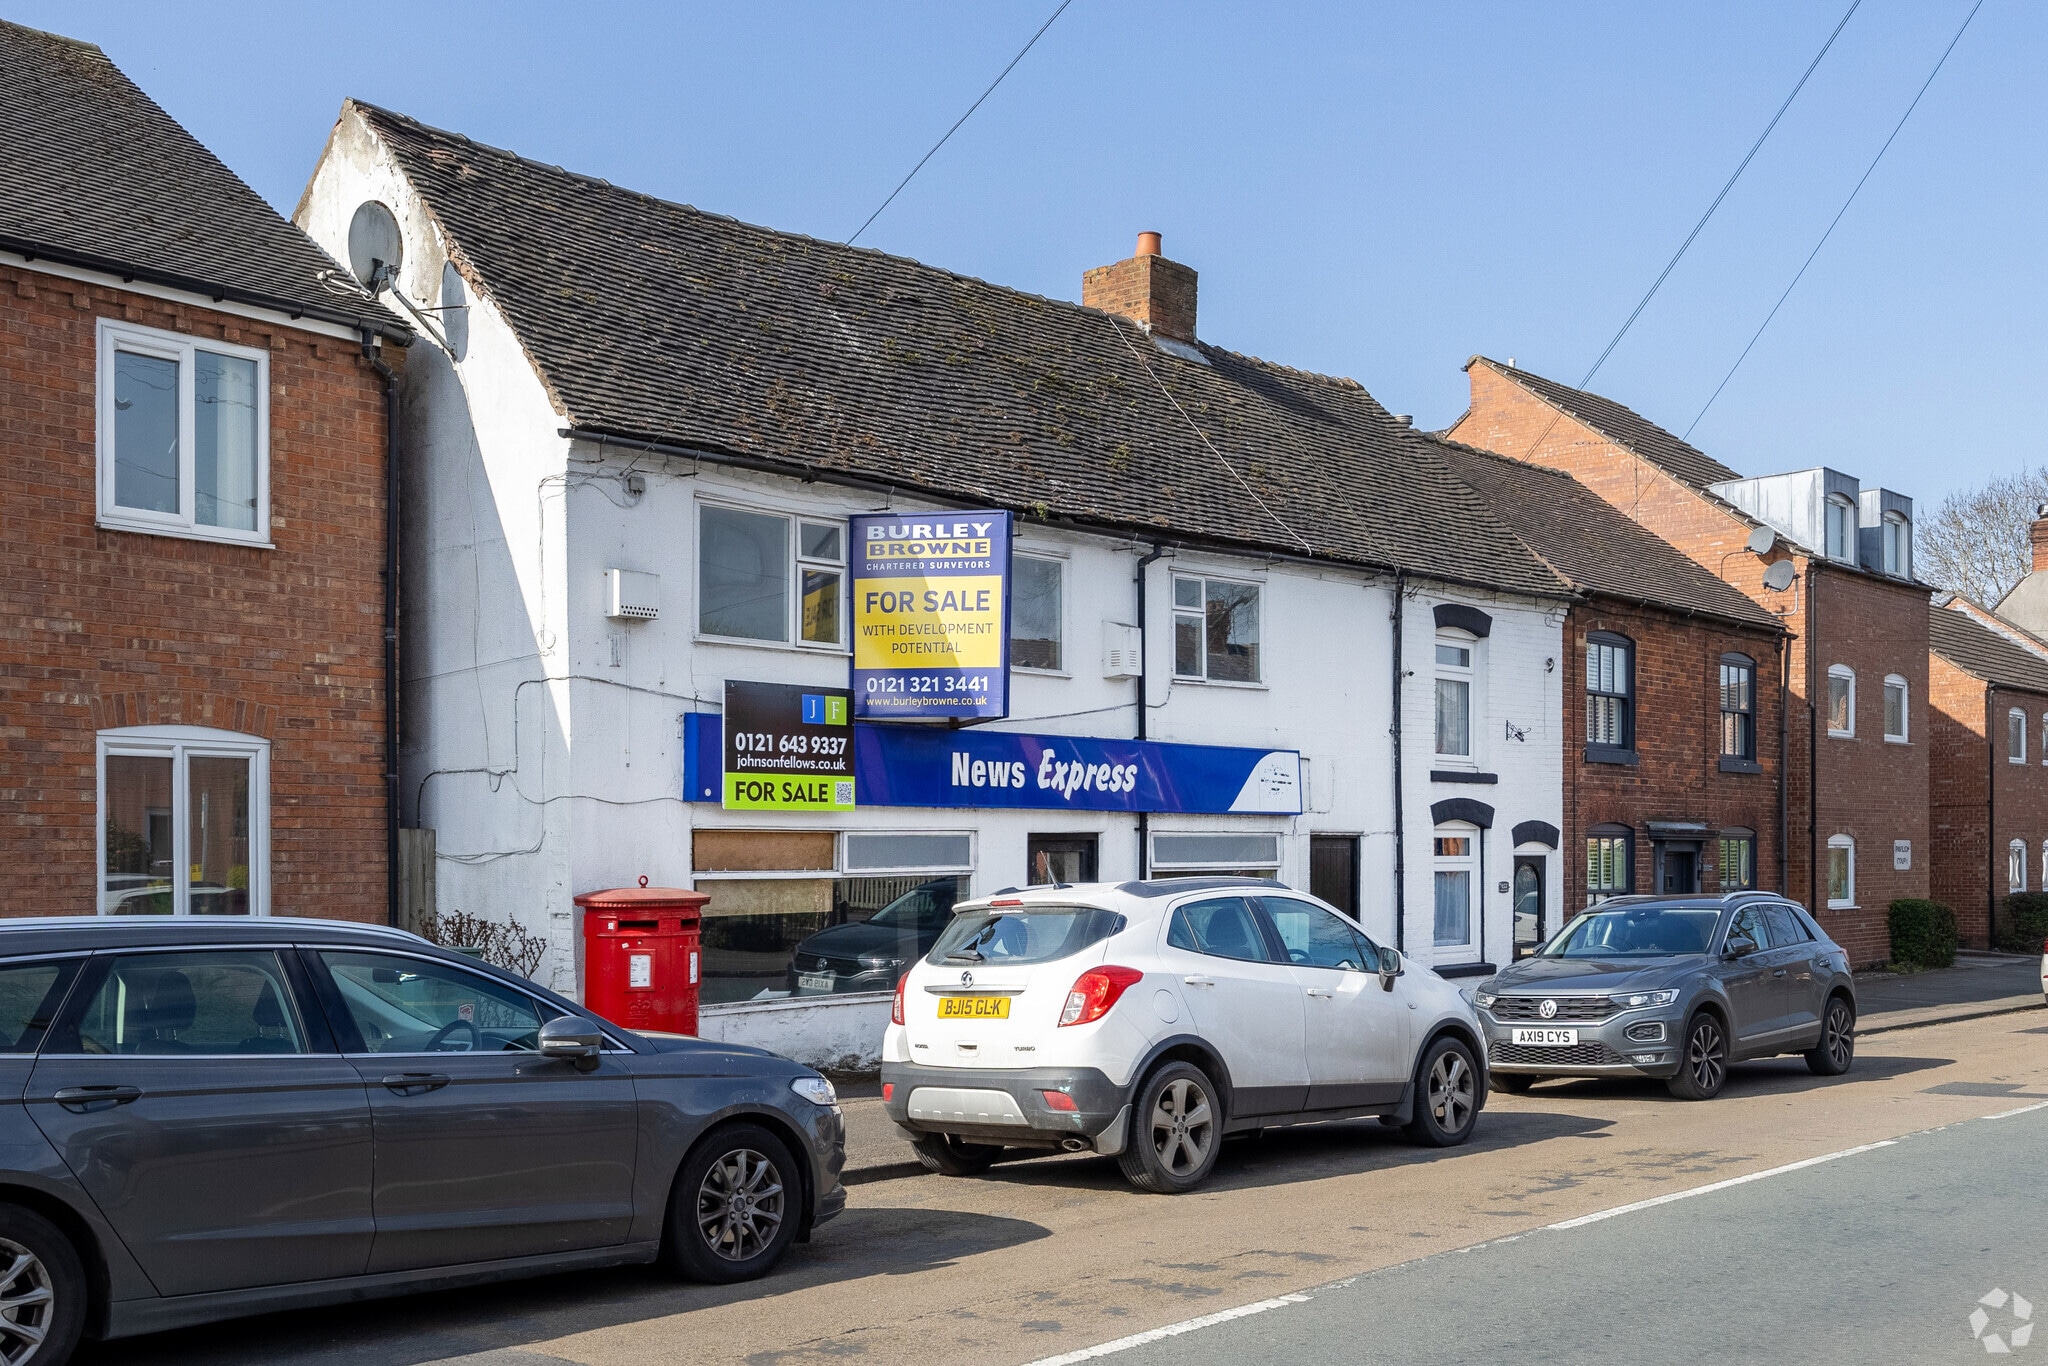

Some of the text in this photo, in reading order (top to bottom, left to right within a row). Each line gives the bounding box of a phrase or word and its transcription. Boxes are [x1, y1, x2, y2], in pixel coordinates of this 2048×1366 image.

[867, 523, 992, 540] BURLEY
[869, 541, 988, 556] BROWNE
[866, 560, 991, 571] CHARTERED SURVEYORS
[866, 590, 990, 614] FOR SALE
[862, 623, 994, 636] WITH DEVELOPMENT
[892, 642, 962, 654] POTENTIAL
[866, 676, 988, 693] 0121 321 3441
[866, 695, 988, 708] www.burleybrowne.co.uk
[735, 732, 847, 755] 0121 643 9337
[737, 753, 846, 771] johnsonfellows.co.uk
[951, 748, 1138, 801] News Express
[735, 780, 829, 803] FOR SALE
[945, 999, 1001, 1015] BJ15 GLK
[1519, 1030, 1570, 1043] AX19 CYS
